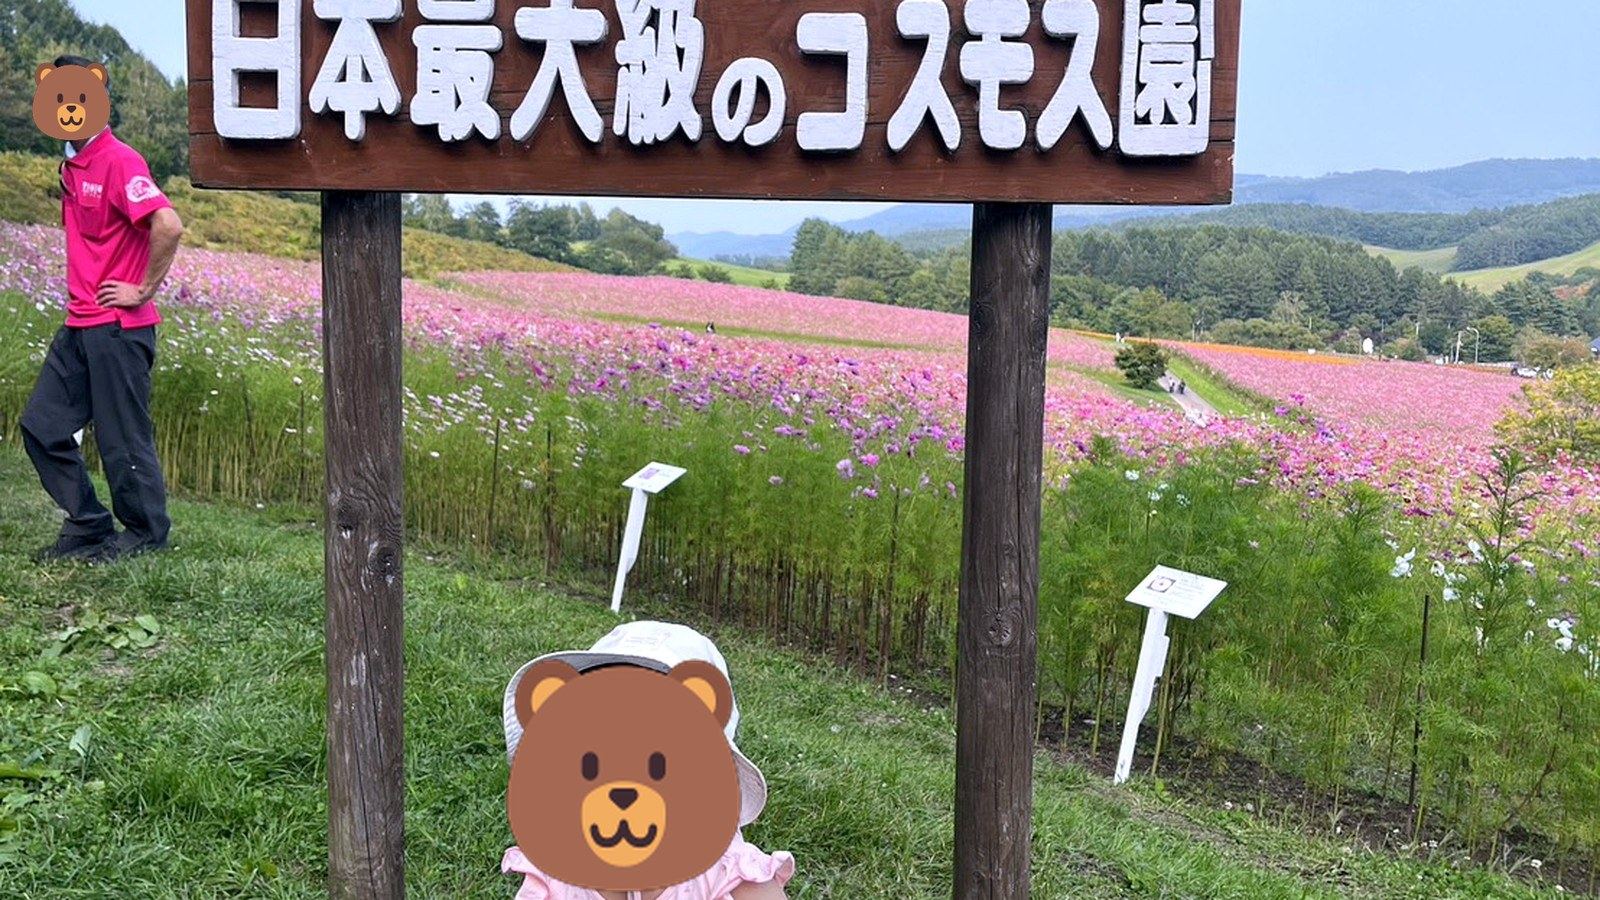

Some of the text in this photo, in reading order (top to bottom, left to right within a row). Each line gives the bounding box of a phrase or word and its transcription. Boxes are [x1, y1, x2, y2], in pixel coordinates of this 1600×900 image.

[212, 0, 1213, 157] 日本最大級のコスモス園
